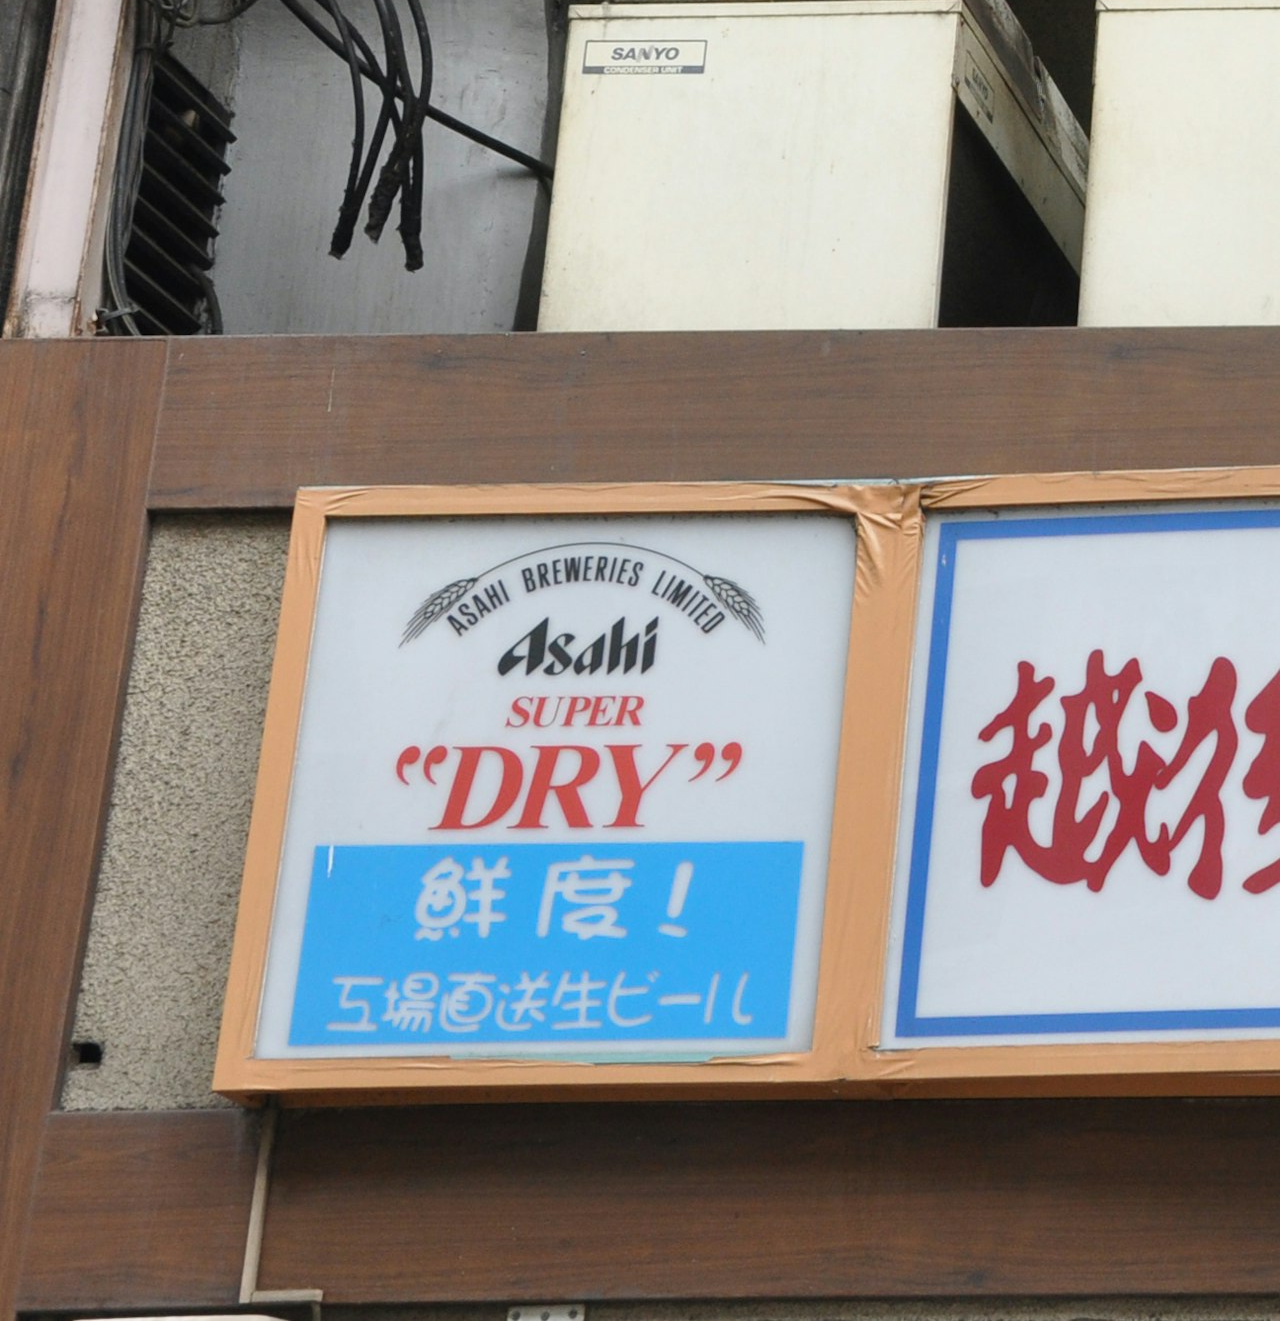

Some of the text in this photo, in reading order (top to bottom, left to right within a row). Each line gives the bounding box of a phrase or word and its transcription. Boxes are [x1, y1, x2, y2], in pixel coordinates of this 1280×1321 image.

[603, 66, 684, 74] CONDENSER UNIT
[611, 46, 680, 62] SANYO
[447, 556, 726, 636] ASAHI BREWERIES LIMITED
[497, 617, 658, 676] Asahi
[504, 695, 645, 728] SUPER
[326, 970, 753, 1033] 工場直送生ビール
